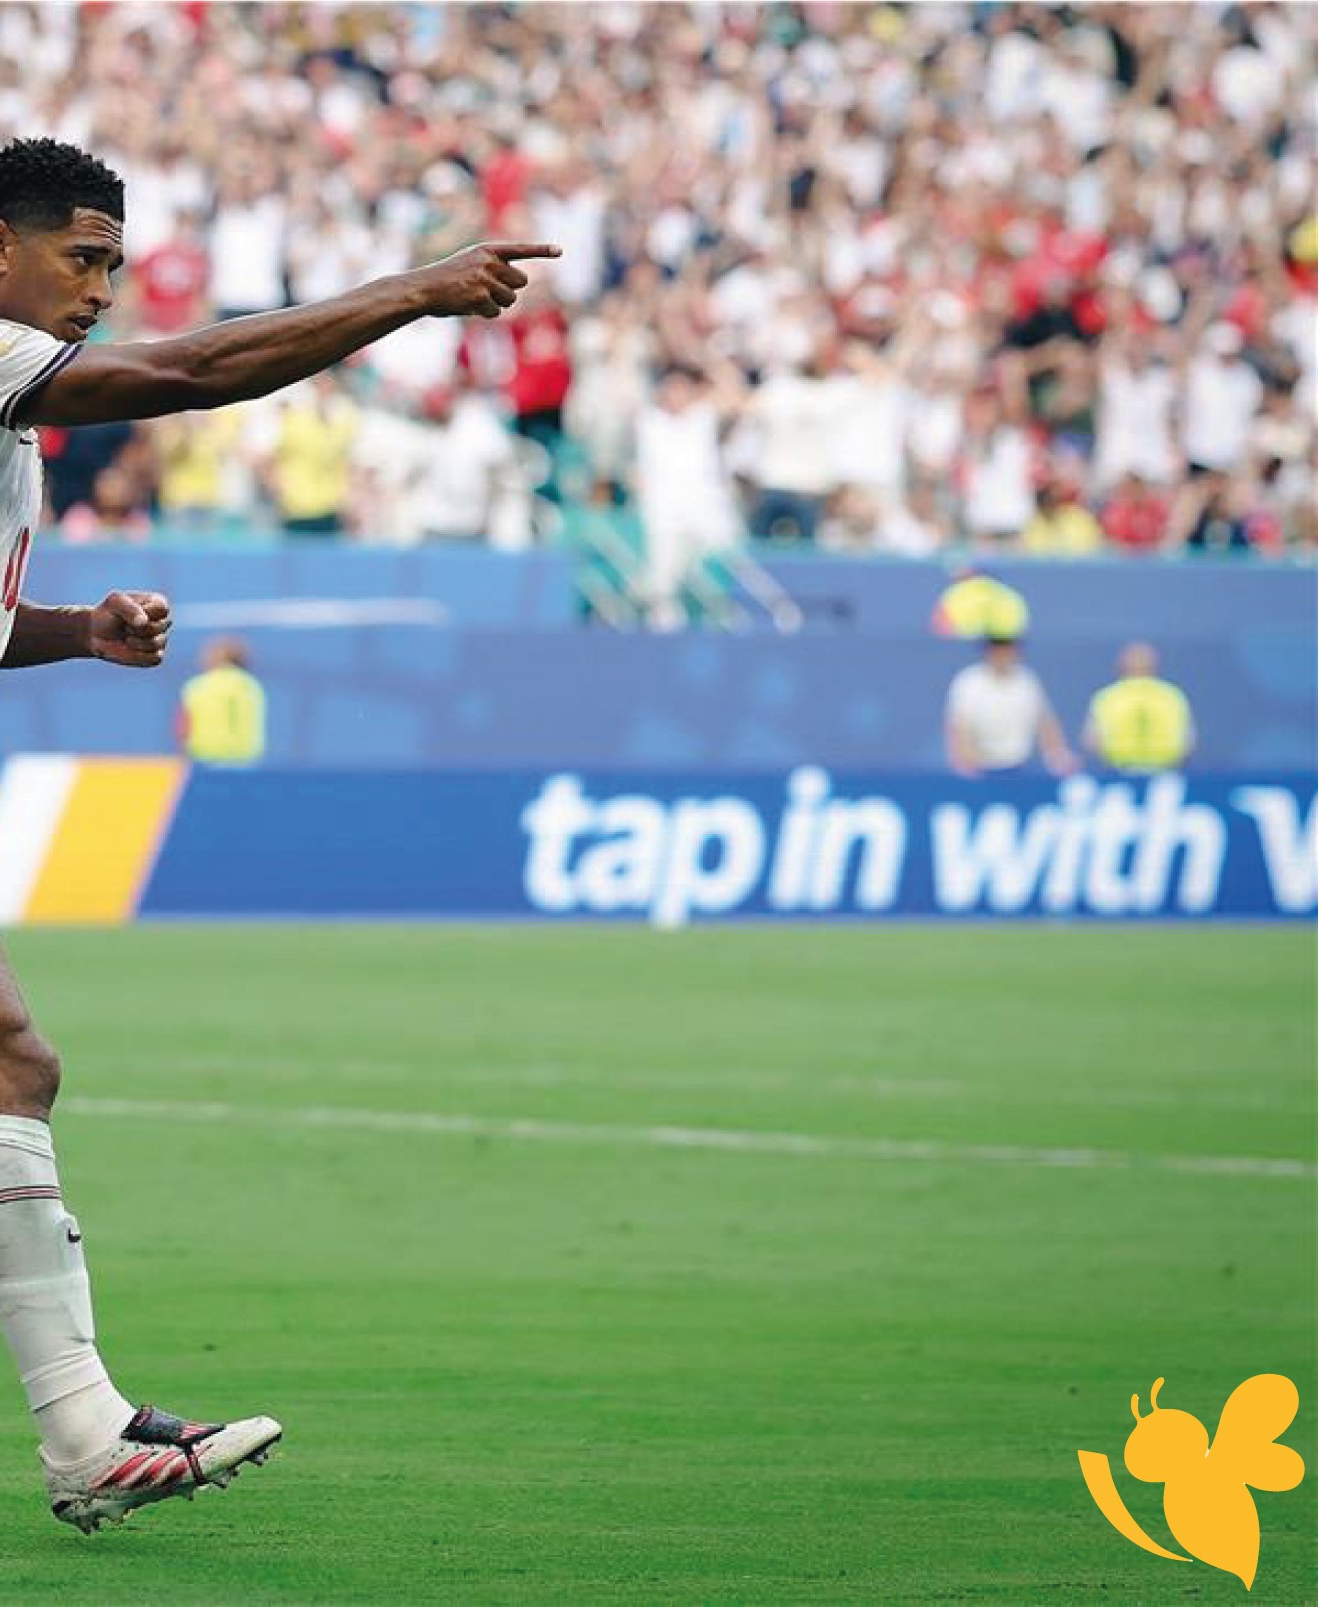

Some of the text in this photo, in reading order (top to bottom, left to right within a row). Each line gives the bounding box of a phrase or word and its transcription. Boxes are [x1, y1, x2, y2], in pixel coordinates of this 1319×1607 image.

[522, 774, 763, 927] tap
[769, 766, 905, 911] in
[930, 773, 1225, 912] with
